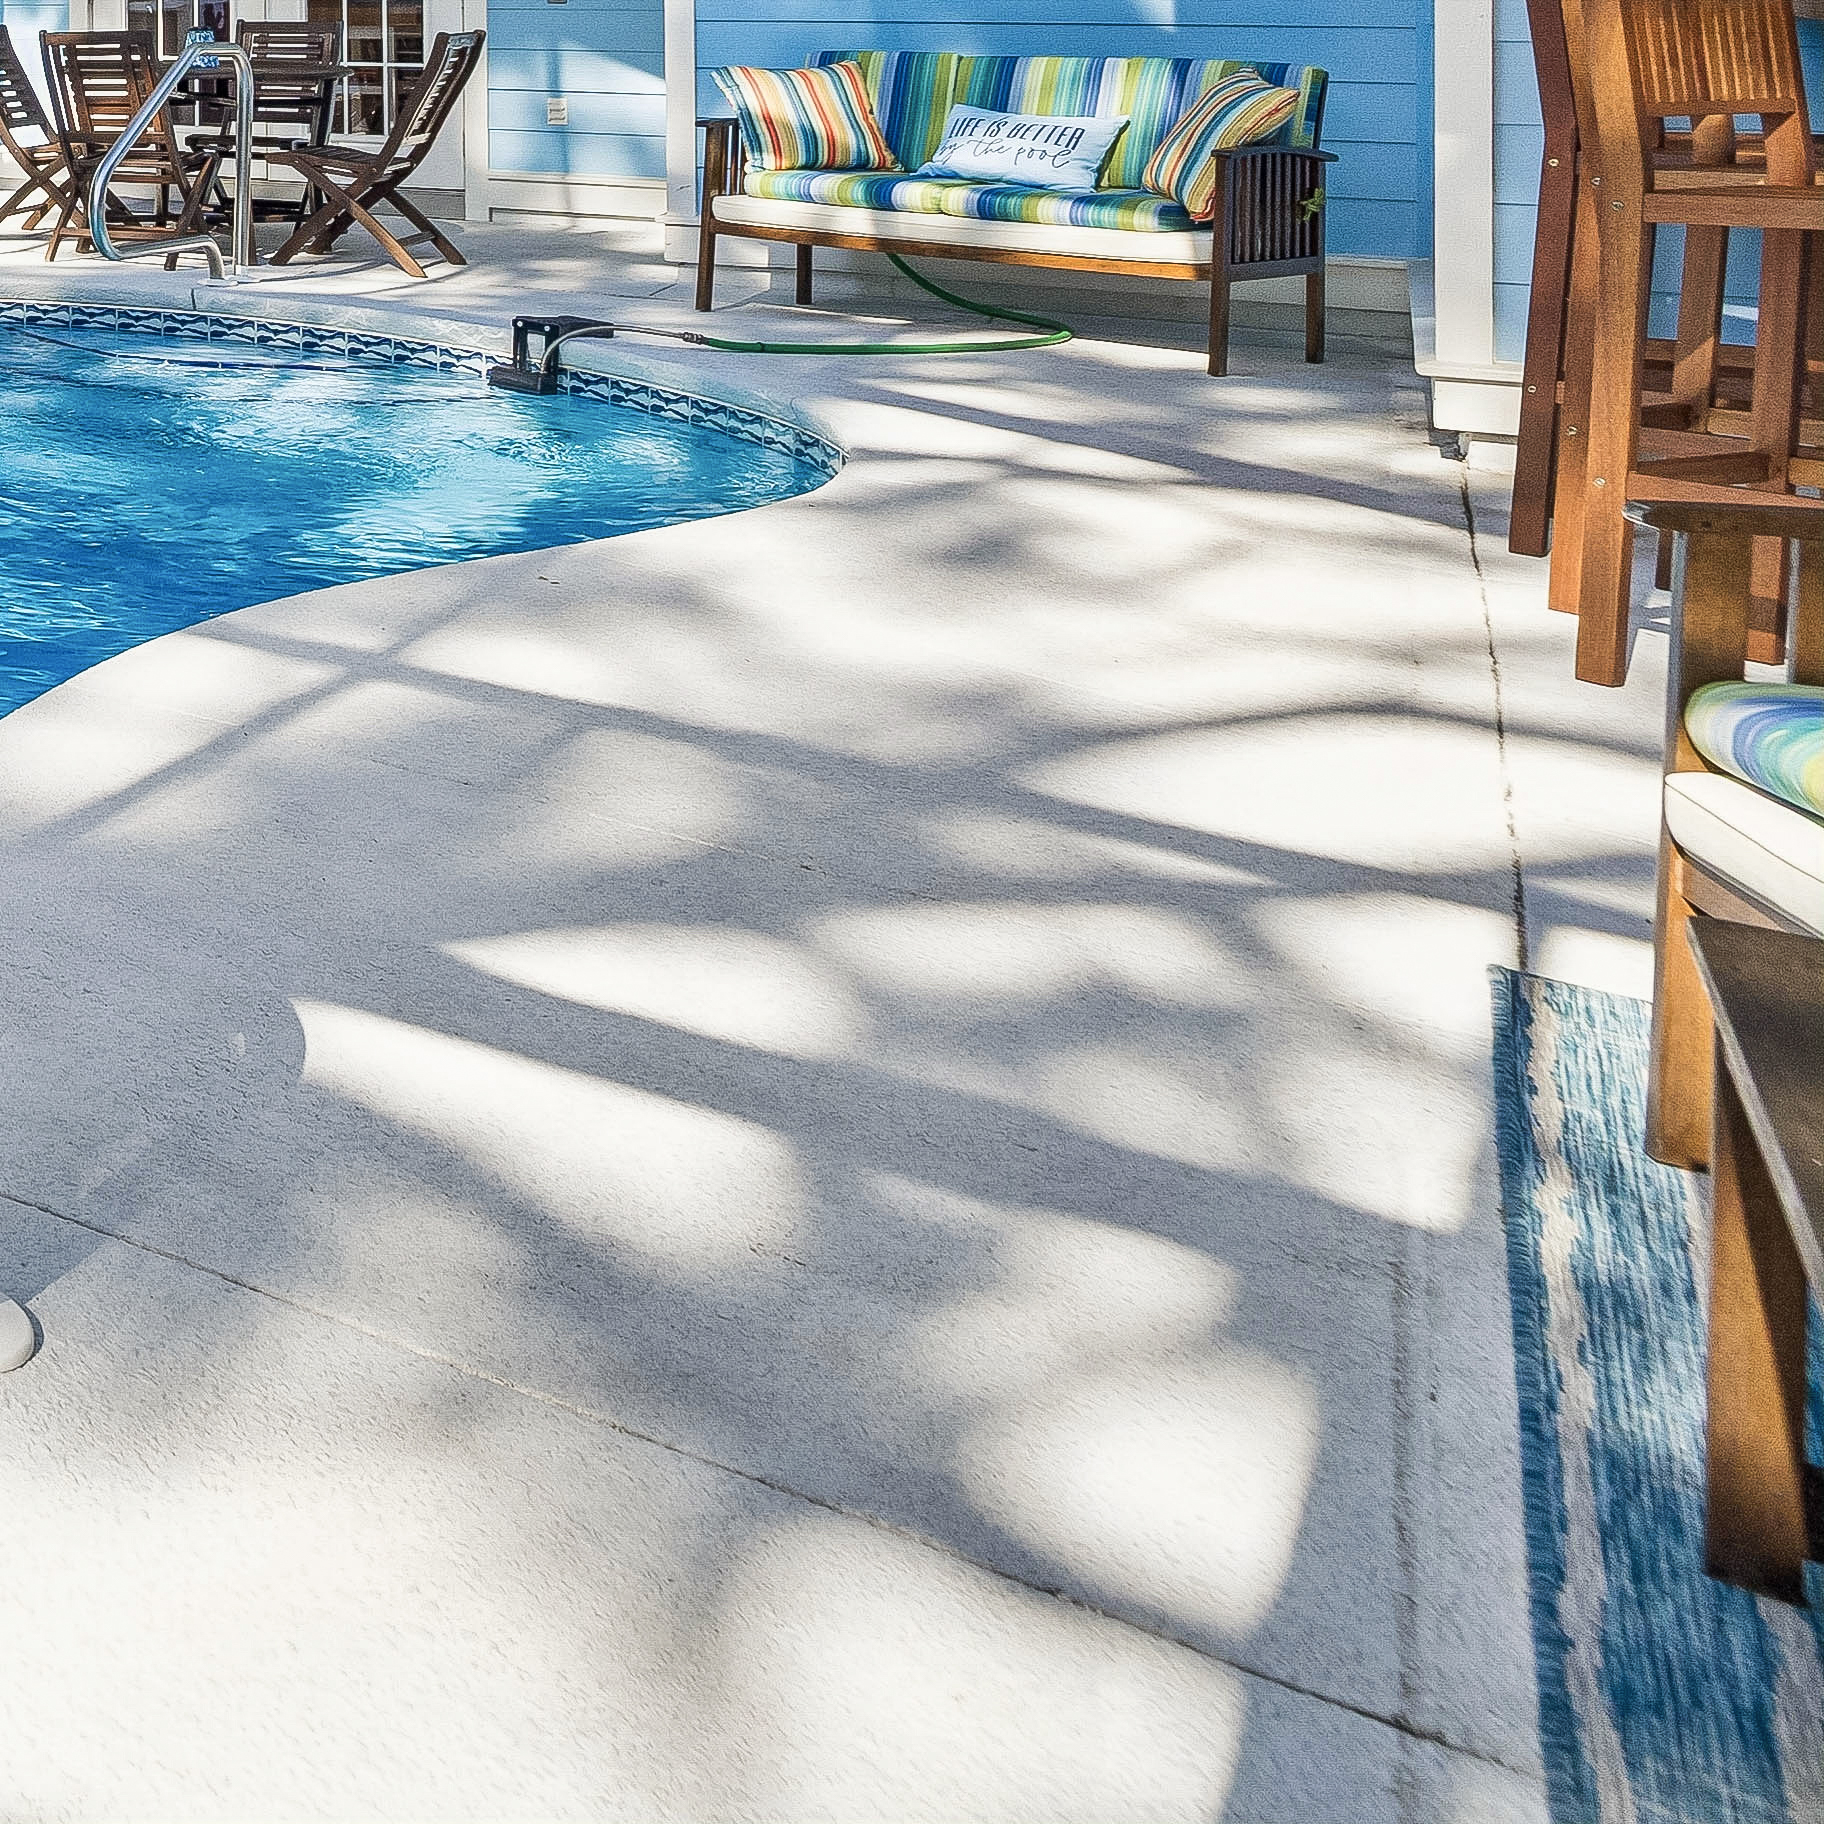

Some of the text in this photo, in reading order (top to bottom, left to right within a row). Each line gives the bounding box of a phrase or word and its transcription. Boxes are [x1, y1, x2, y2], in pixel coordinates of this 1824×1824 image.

[948, 116, 1086, 151] LIFE IS BETTER
[967, 138, 1012, 158] the
[1013, 146, 1072, 169] pool
